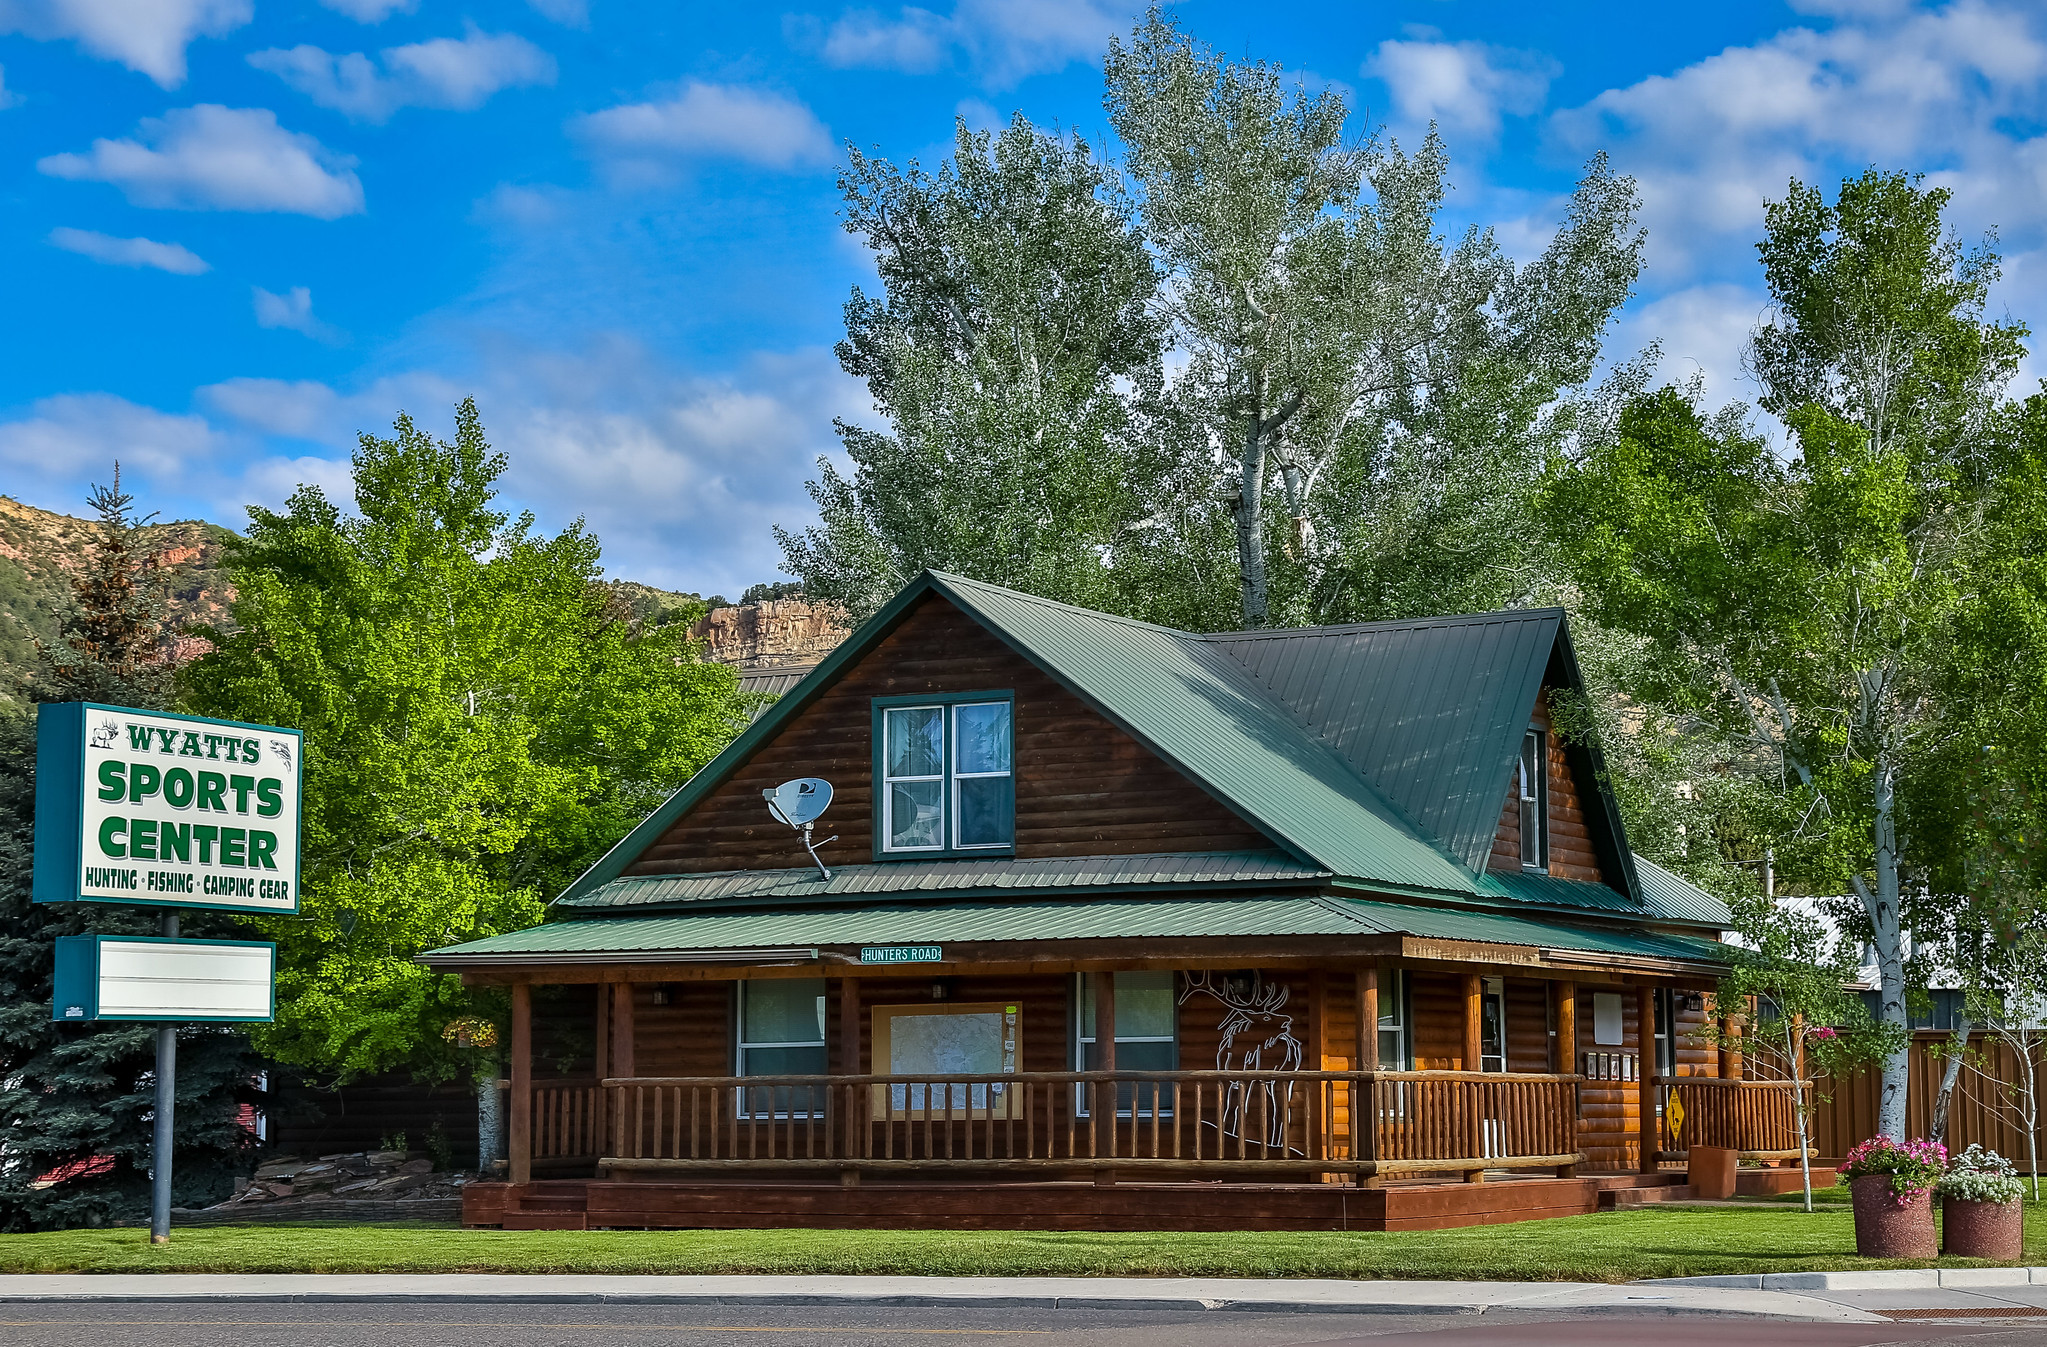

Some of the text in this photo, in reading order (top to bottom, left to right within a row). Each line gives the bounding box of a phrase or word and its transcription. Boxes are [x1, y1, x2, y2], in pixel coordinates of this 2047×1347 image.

[125, 723, 260, 765] WYATTS
[98, 760, 283, 818] SPORTS
[98, 816, 279, 872] CENTER
[85, 866, 290, 901] HUNTING FISHING CAMPING GEAR
[864, 948, 938, 961] HUNTERS ROAD
